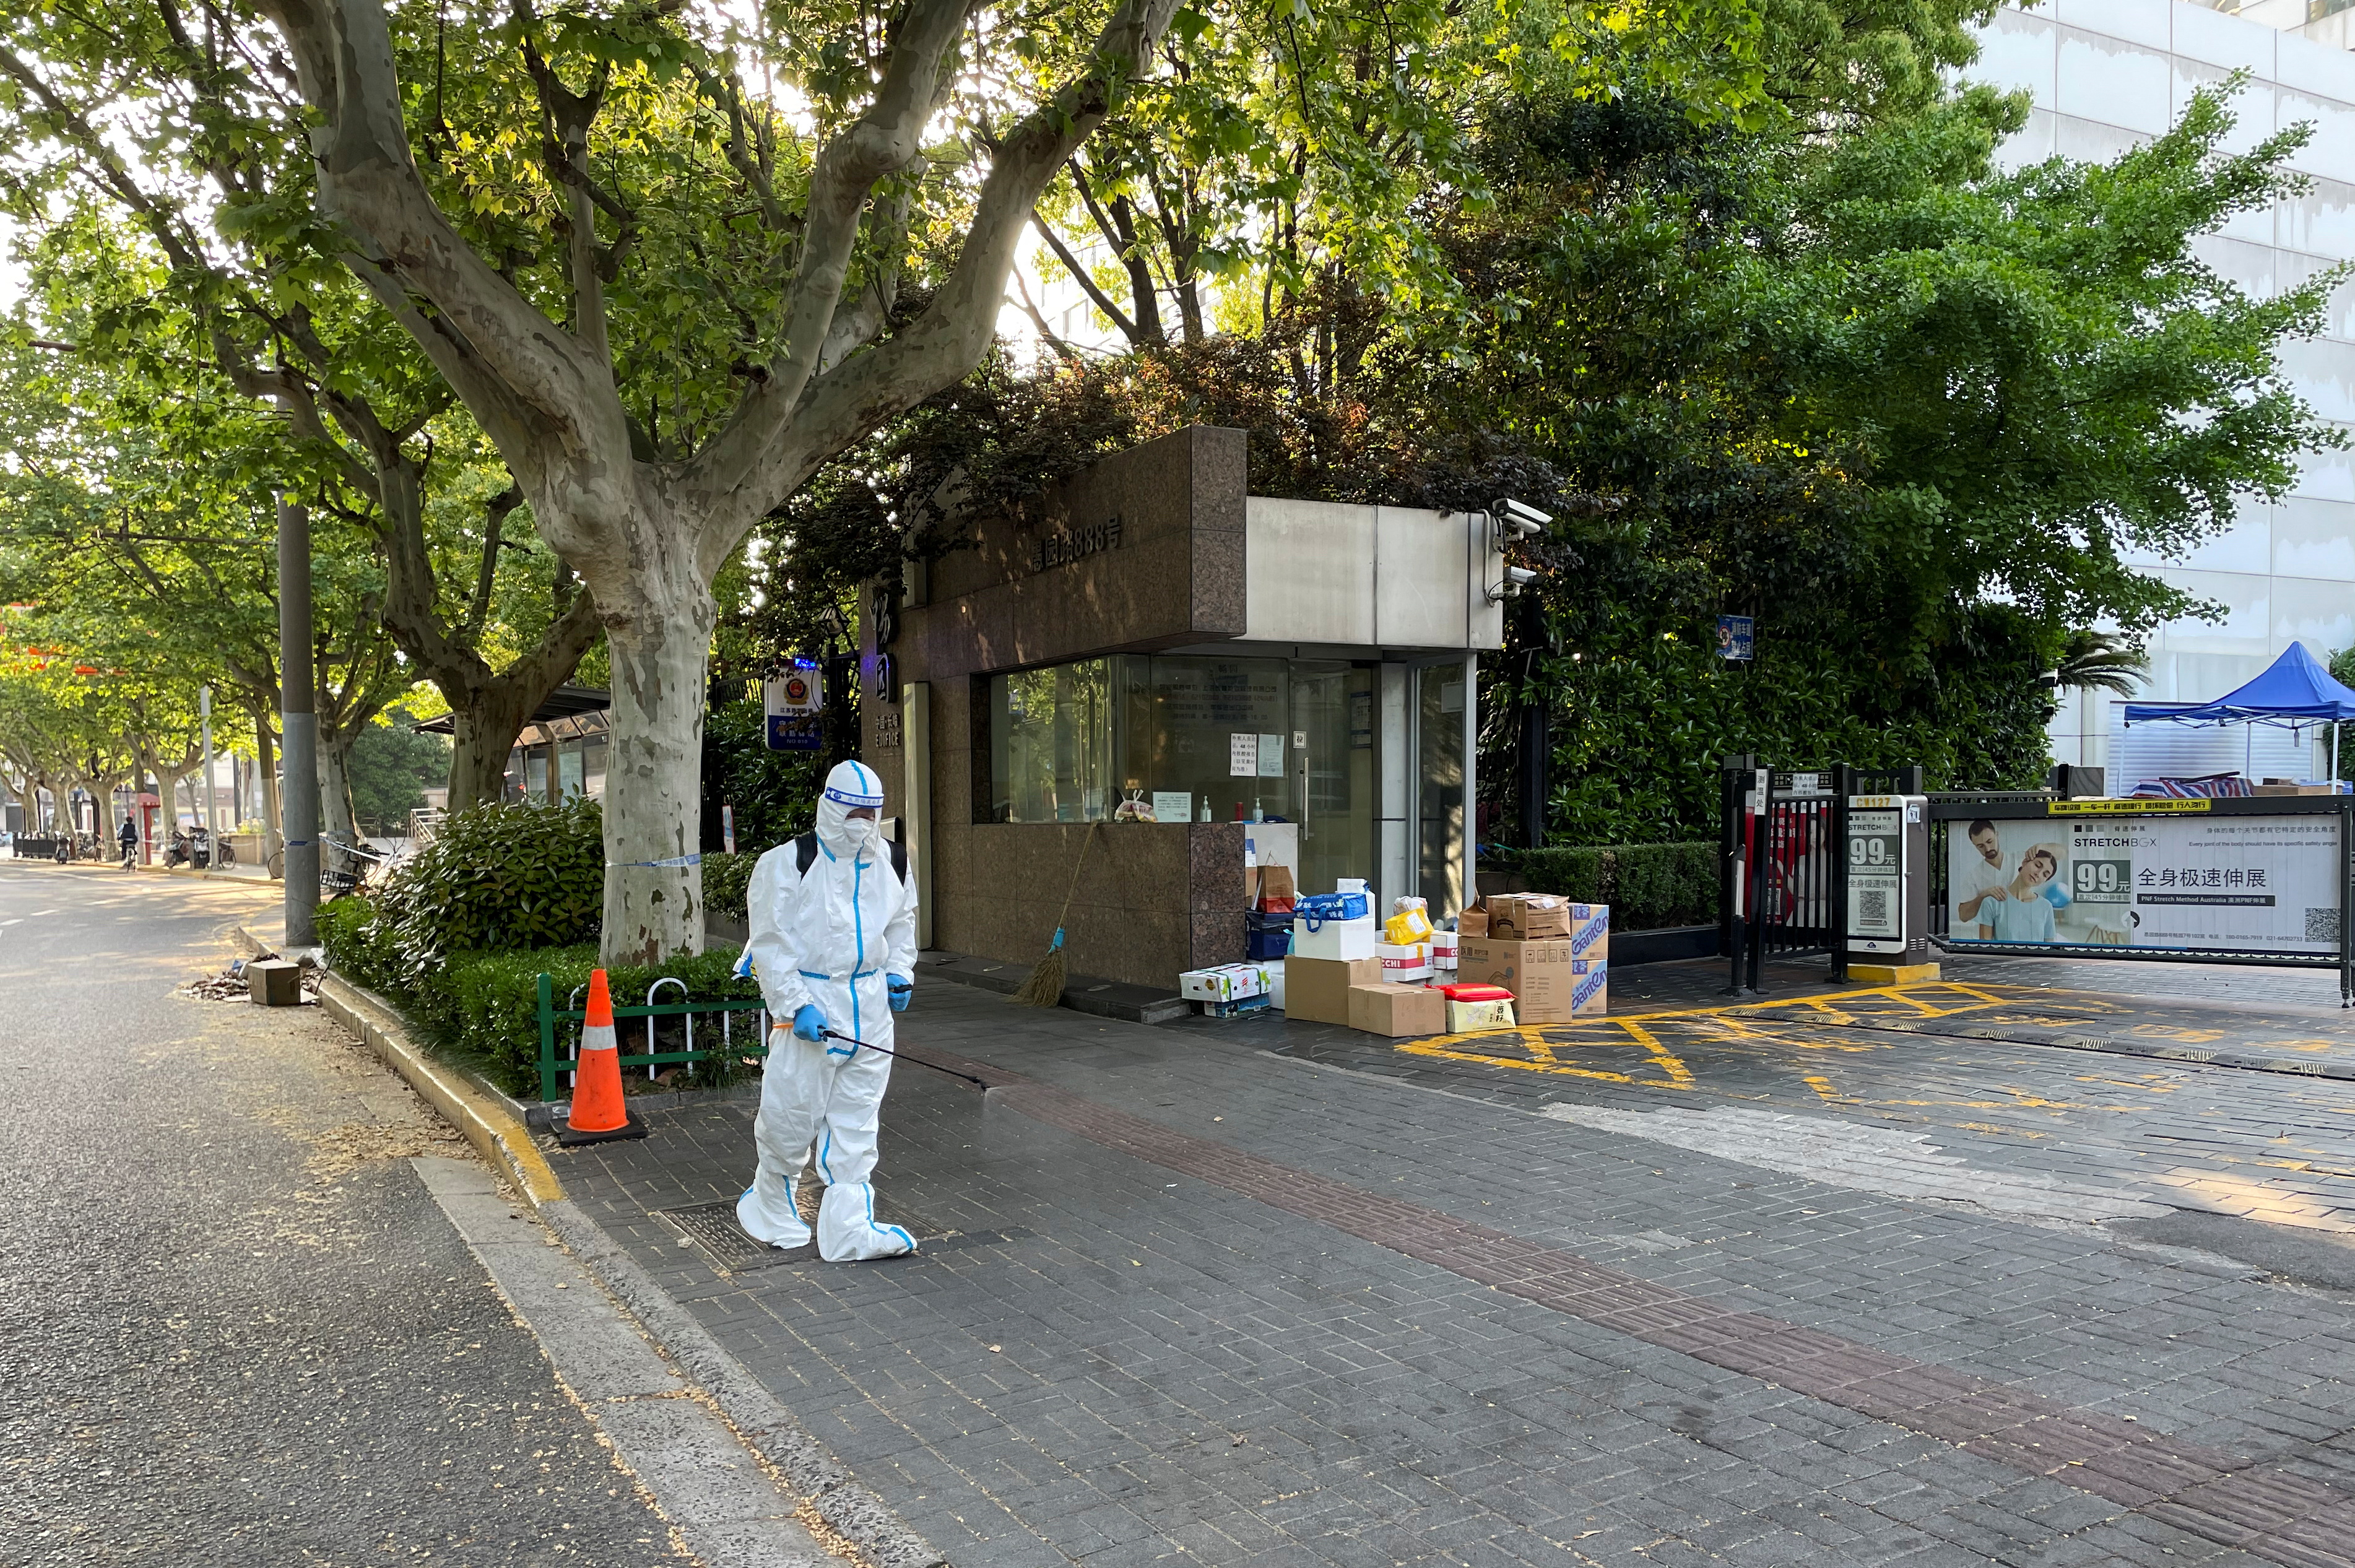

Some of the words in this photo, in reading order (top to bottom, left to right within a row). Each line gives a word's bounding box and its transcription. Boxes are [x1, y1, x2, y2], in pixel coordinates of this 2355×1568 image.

[876, 732, 899, 747] EDIFICE
[1756, 776, 1765, 808] 测温处
[1848, 879, 1897, 888] 全身极速伸展
[2138, 868, 2266, 888] 全身极速伸展
